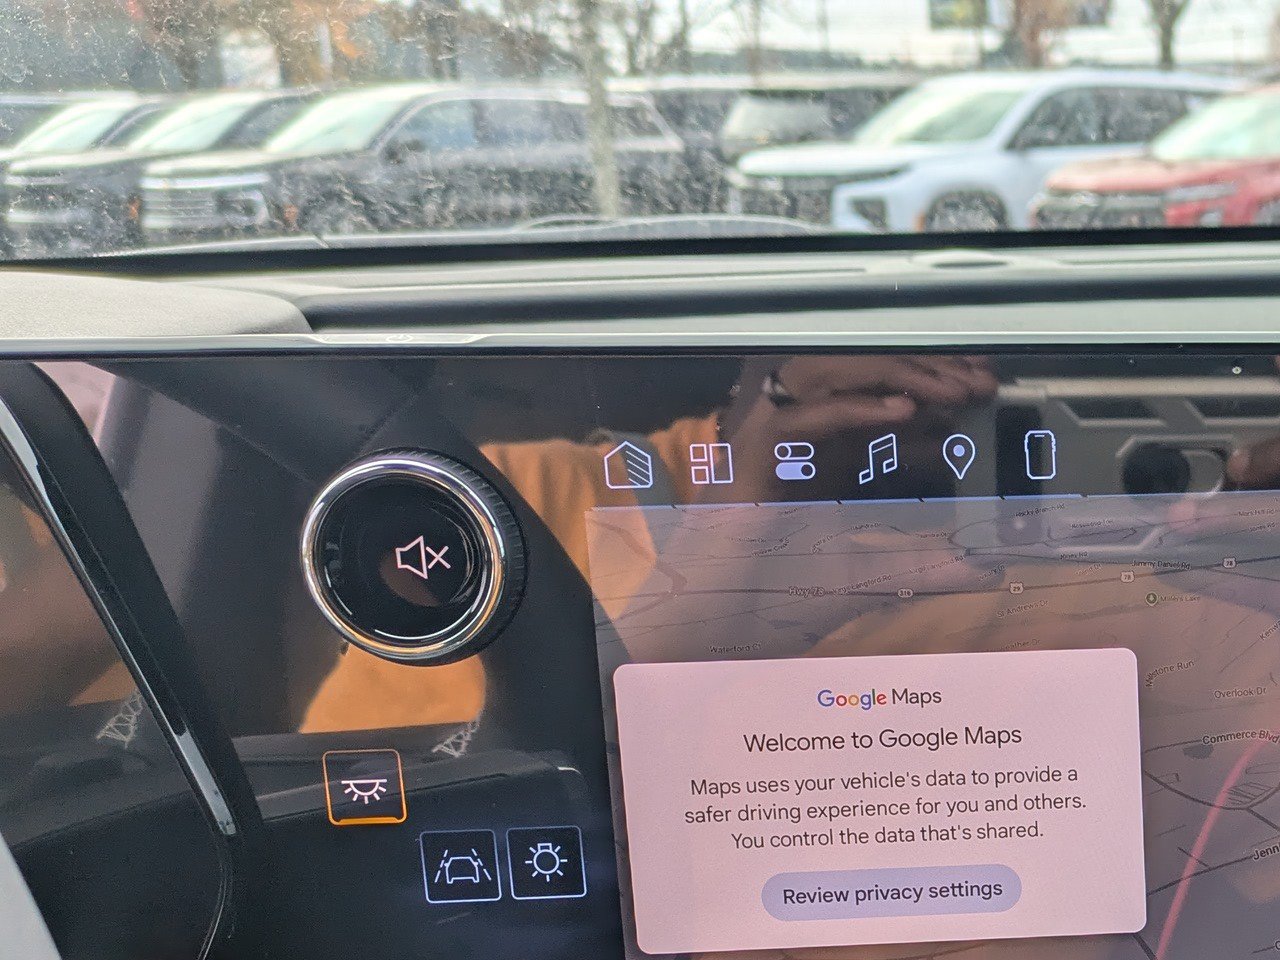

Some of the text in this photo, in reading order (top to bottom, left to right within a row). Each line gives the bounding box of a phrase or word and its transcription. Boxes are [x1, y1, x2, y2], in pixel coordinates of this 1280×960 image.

[1132, 561, 1155, 569] Jimmy
[789, 586, 810, 597] Hwy
[1039, 599, 1048, 608] Dr
[817, 686, 942, 711] Google Maps
[1214, 686, 1267, 699] Overlook Dr
[743, 724, 1022, 753] Welcome to Google Maps
[1202, 728, 1280, 746] Commerce Blvd
[690, 764, 1078, 800] Maps uses your vehicle's data to provide a
[685, 790, 1087, 826] safer driving experience for you and others.
[732, 818, 1044, 849] You control the data that's shared.
[783, 878, 1003, 907] Review privacy settings
